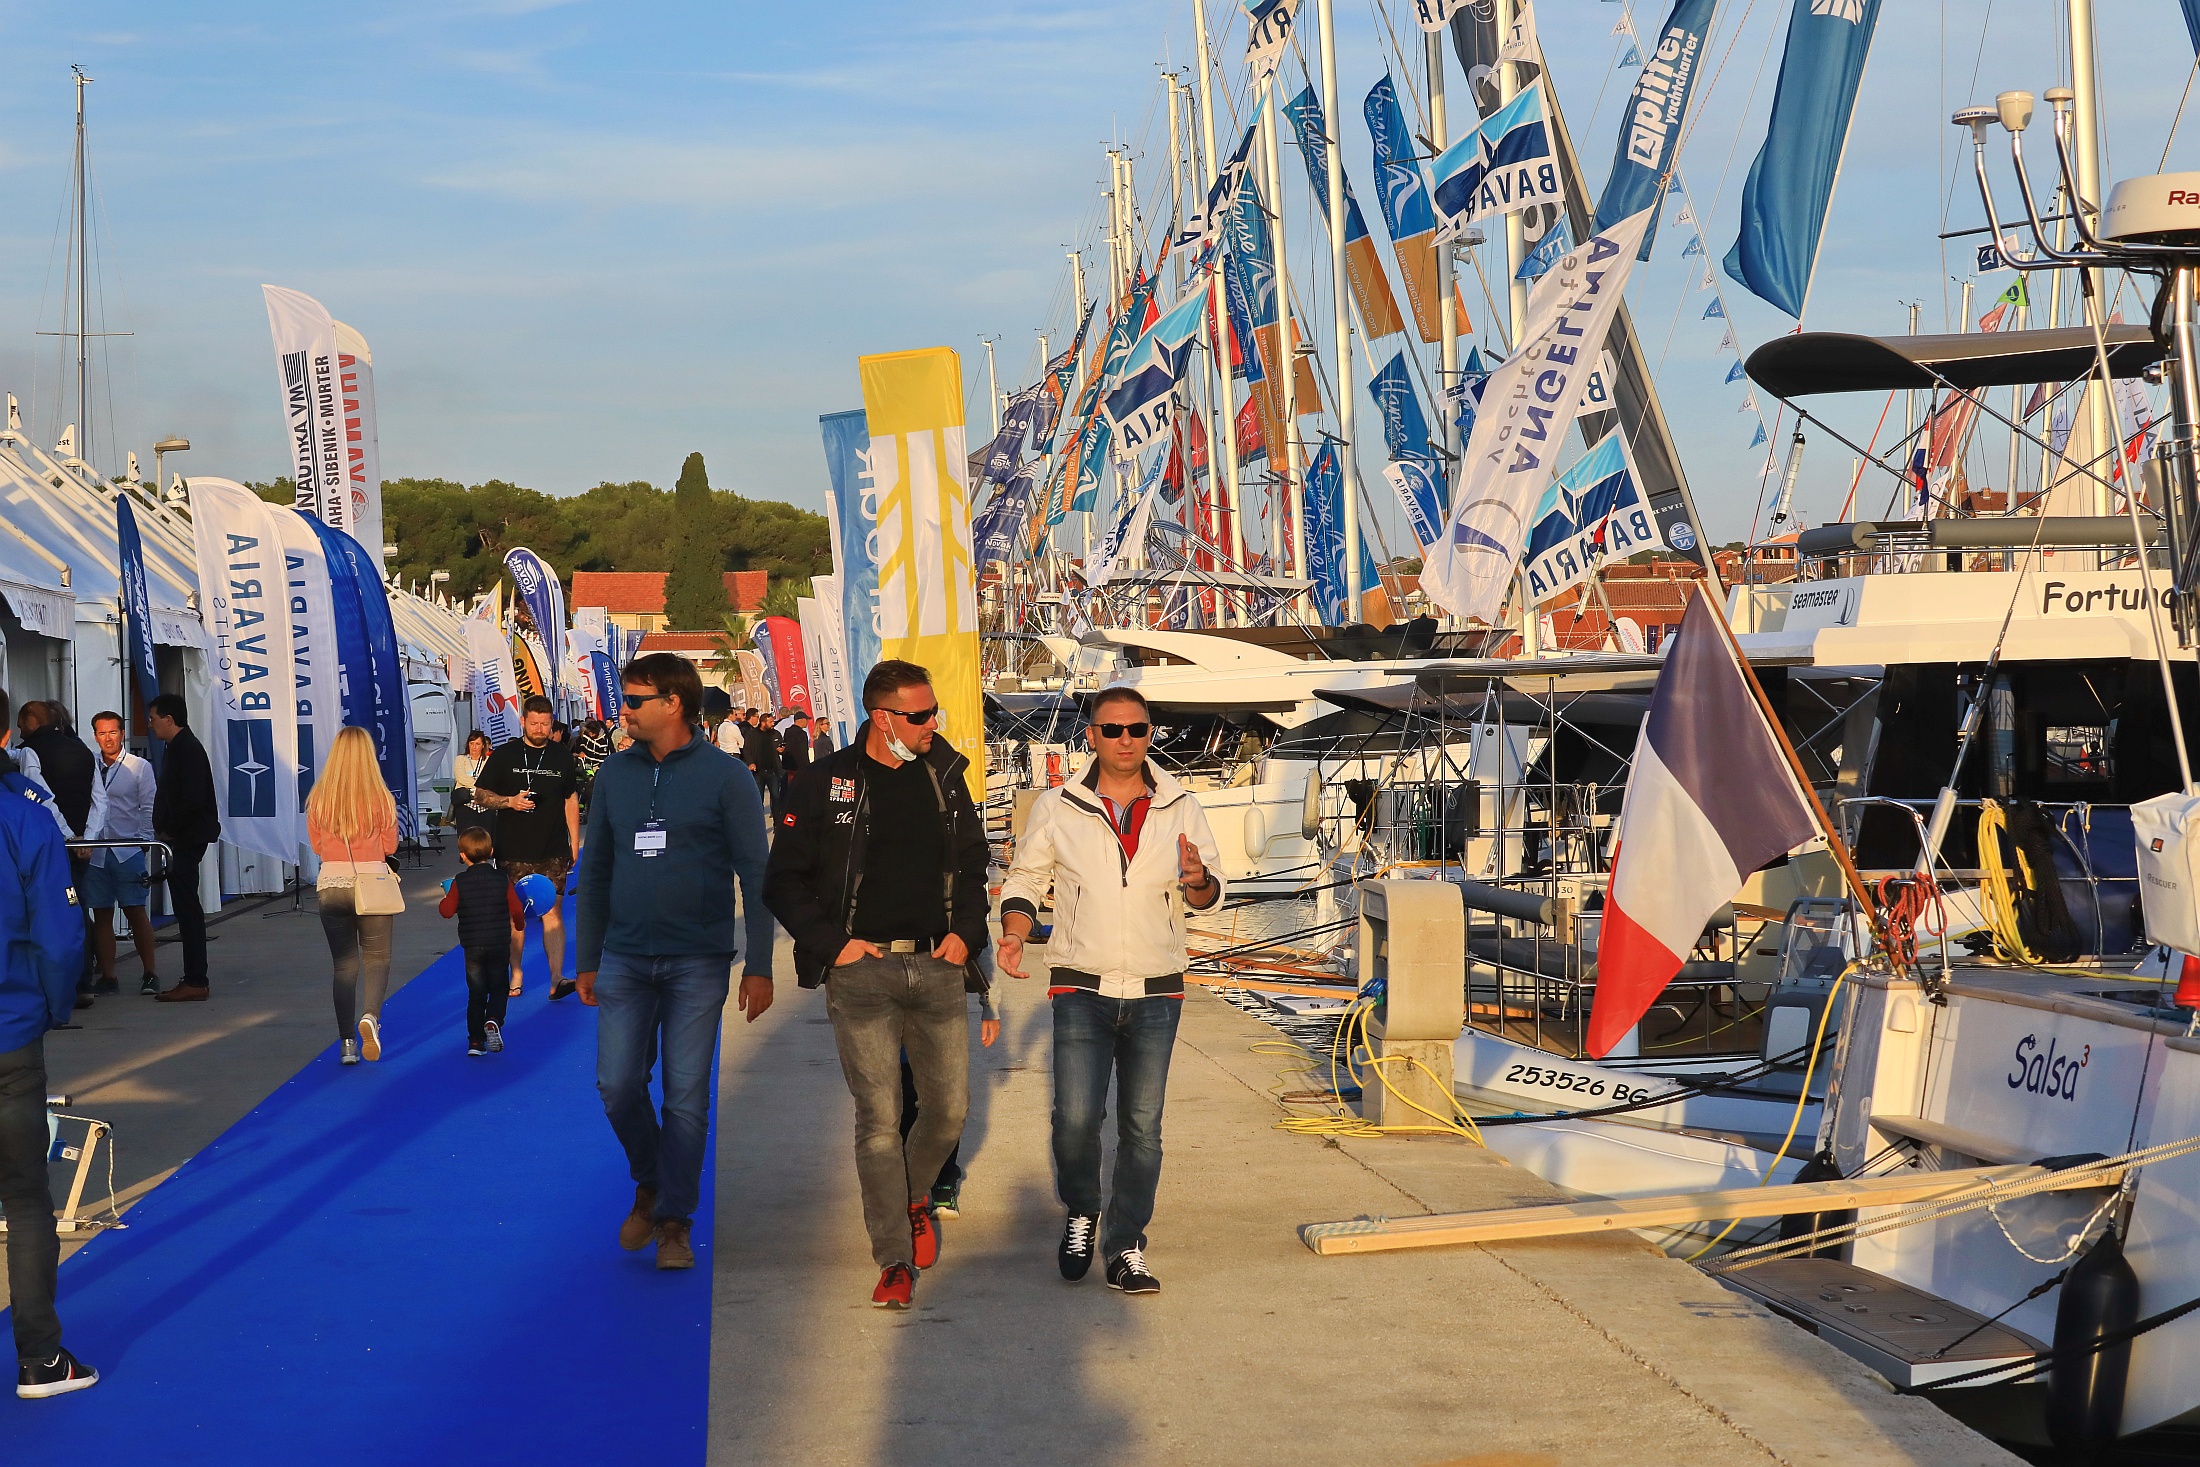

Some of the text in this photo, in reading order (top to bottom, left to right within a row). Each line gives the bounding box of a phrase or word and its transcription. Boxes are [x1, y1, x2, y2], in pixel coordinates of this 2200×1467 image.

[1665, 32, 1699, 125] yachtcharter
[2168, 190, 2200, 208] Ra
[1346, 250, 1379, 333] hanseyachts.com
[1397, 247, 1431, 339] hanseyachts.com
[289, 384, 307, 417] VM
[1379, 379, 1410, 445] Hanse
[57, 438, 70, 446] est
[315, 354, 343, 530] AHA ŠIBENIK MURTER
[985, 538, 1013, 549] Novak
[1792, 587, 1839, 611] seamaster
[1555, 886, 1574, 894] 30
[2147, 873, 2178, 891] RESCUER
[1505, 1064, 1649, 1109] 253526 BG
